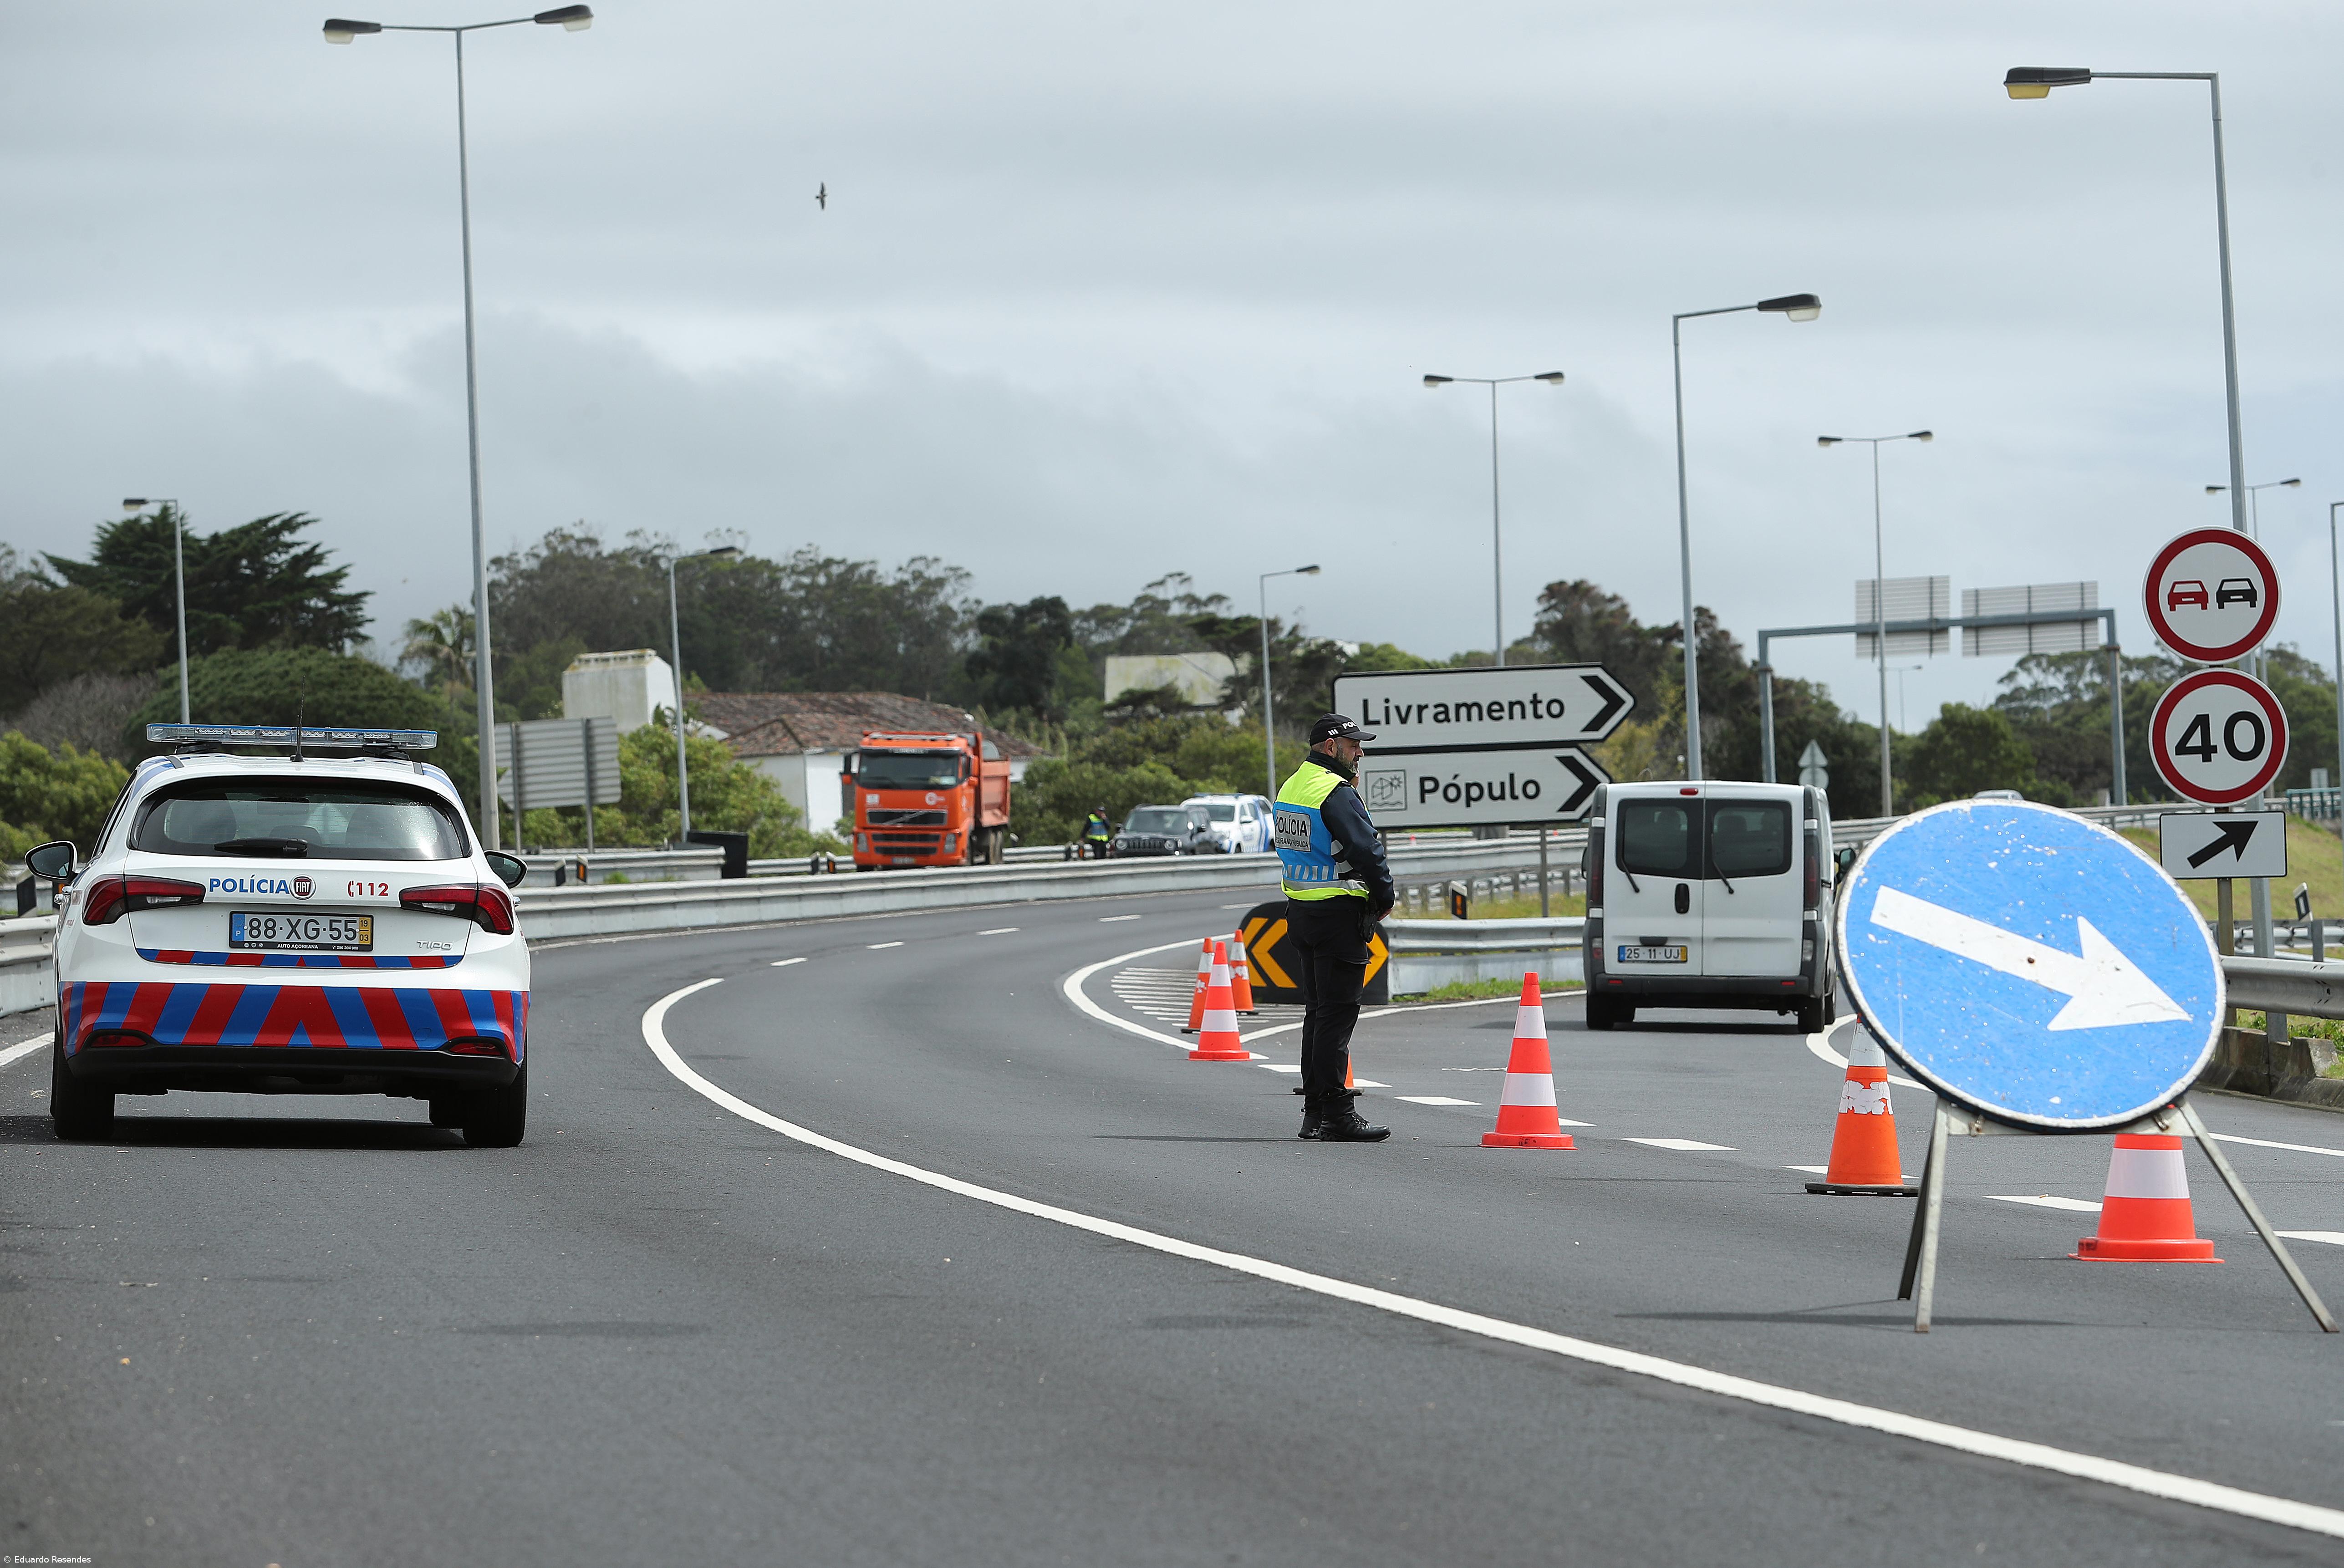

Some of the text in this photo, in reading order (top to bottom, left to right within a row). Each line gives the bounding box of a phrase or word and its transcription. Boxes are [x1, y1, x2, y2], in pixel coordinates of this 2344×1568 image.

[1362, 692, 1565, 726] Livramento
[2174, 710, 2266, 763] 40
[1419, 772, 1541, 808] Pópulo
[209, 875, 290, 894] POLÍCIA
[296, 881, 310, 893] FIAT
[357, 882, 389, 896] 112
[417, 940, 454, 951] TIPO
